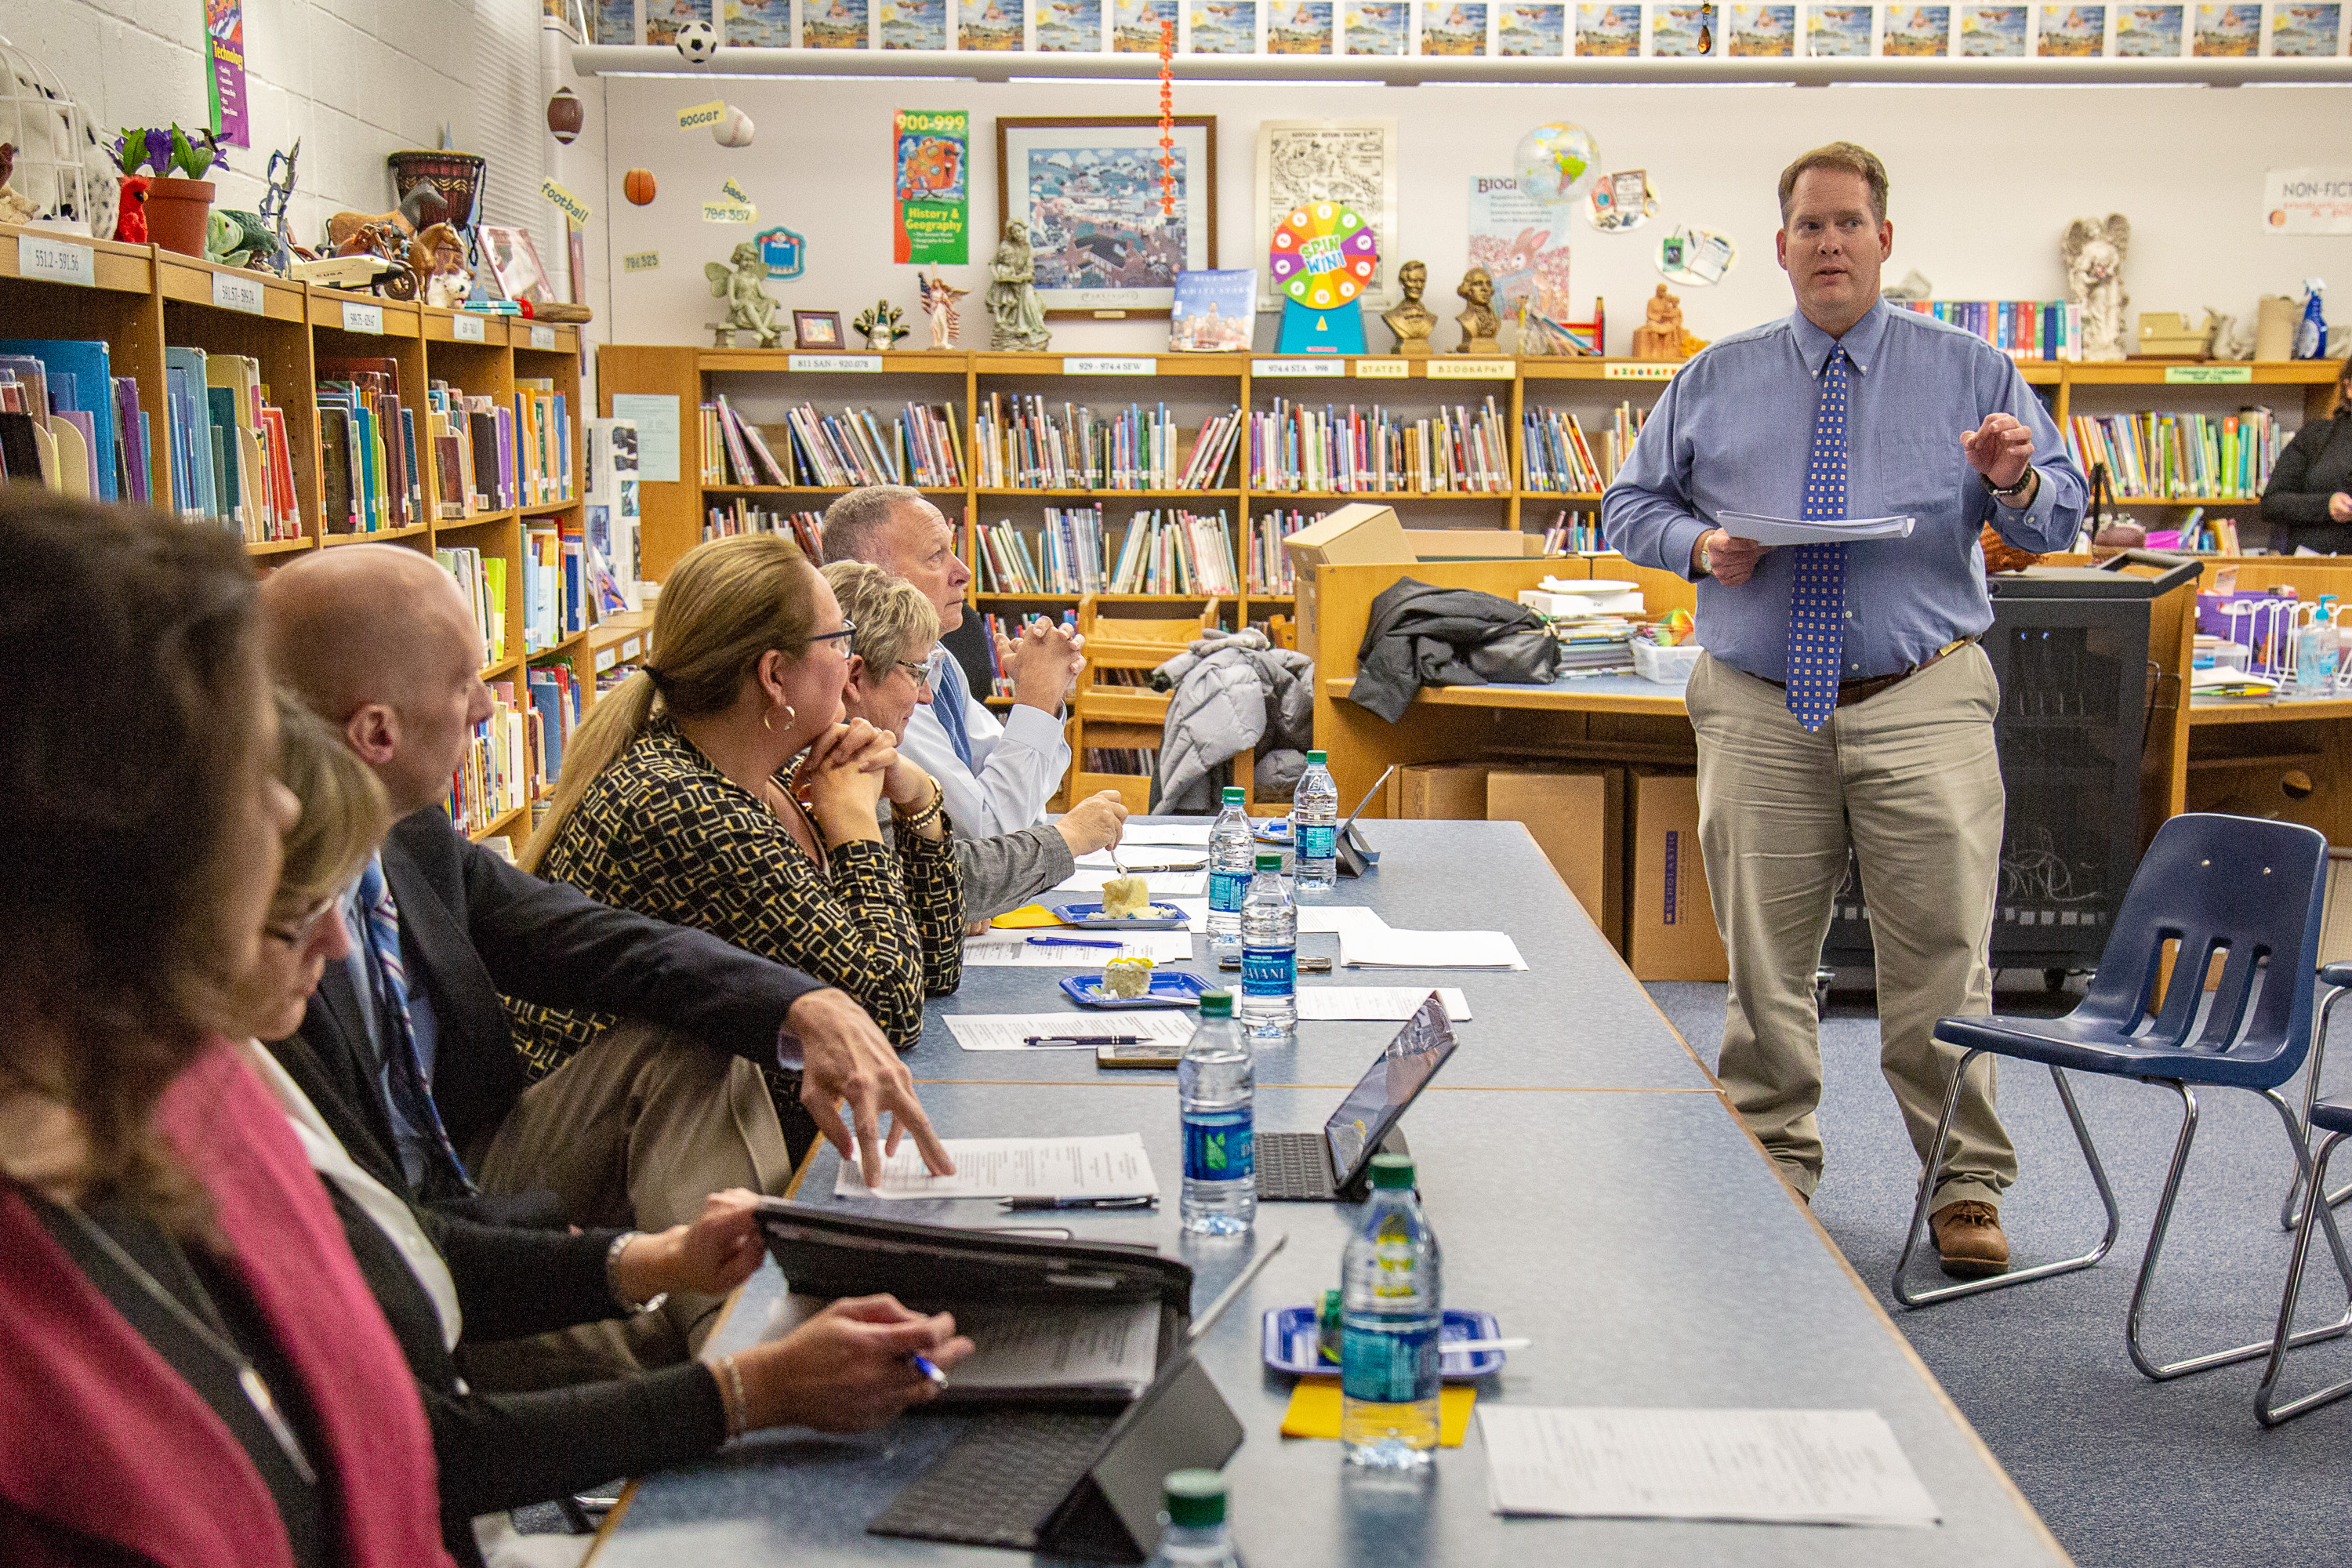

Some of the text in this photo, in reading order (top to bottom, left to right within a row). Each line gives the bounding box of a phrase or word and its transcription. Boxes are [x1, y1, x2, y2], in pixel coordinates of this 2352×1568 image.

[213, 41, 243, 71] Technology
[680, 110, 719, 127] soccer
[896, 114, 965, 131] 900-999
[722, 182, 750, 203] base
[1478, 178, 1517, 194] BIOG
[541, 183, 589, 223] football
[704, 207, 750, 221] 796.357
[909, 208, 960, 220] History &
[906, 219, 962, 233] Geography
[1301, 237, 1339, 259] SPIN
[35, 250, 54, 268] 551.2
[59, 252, 79, 271] 591.56
[839, 360, 869, 368] 920.078
[1438, 365, 1505, 374] BIOGRAPHY
[1666, 833, 1676, 913] SCHOLASTIC
